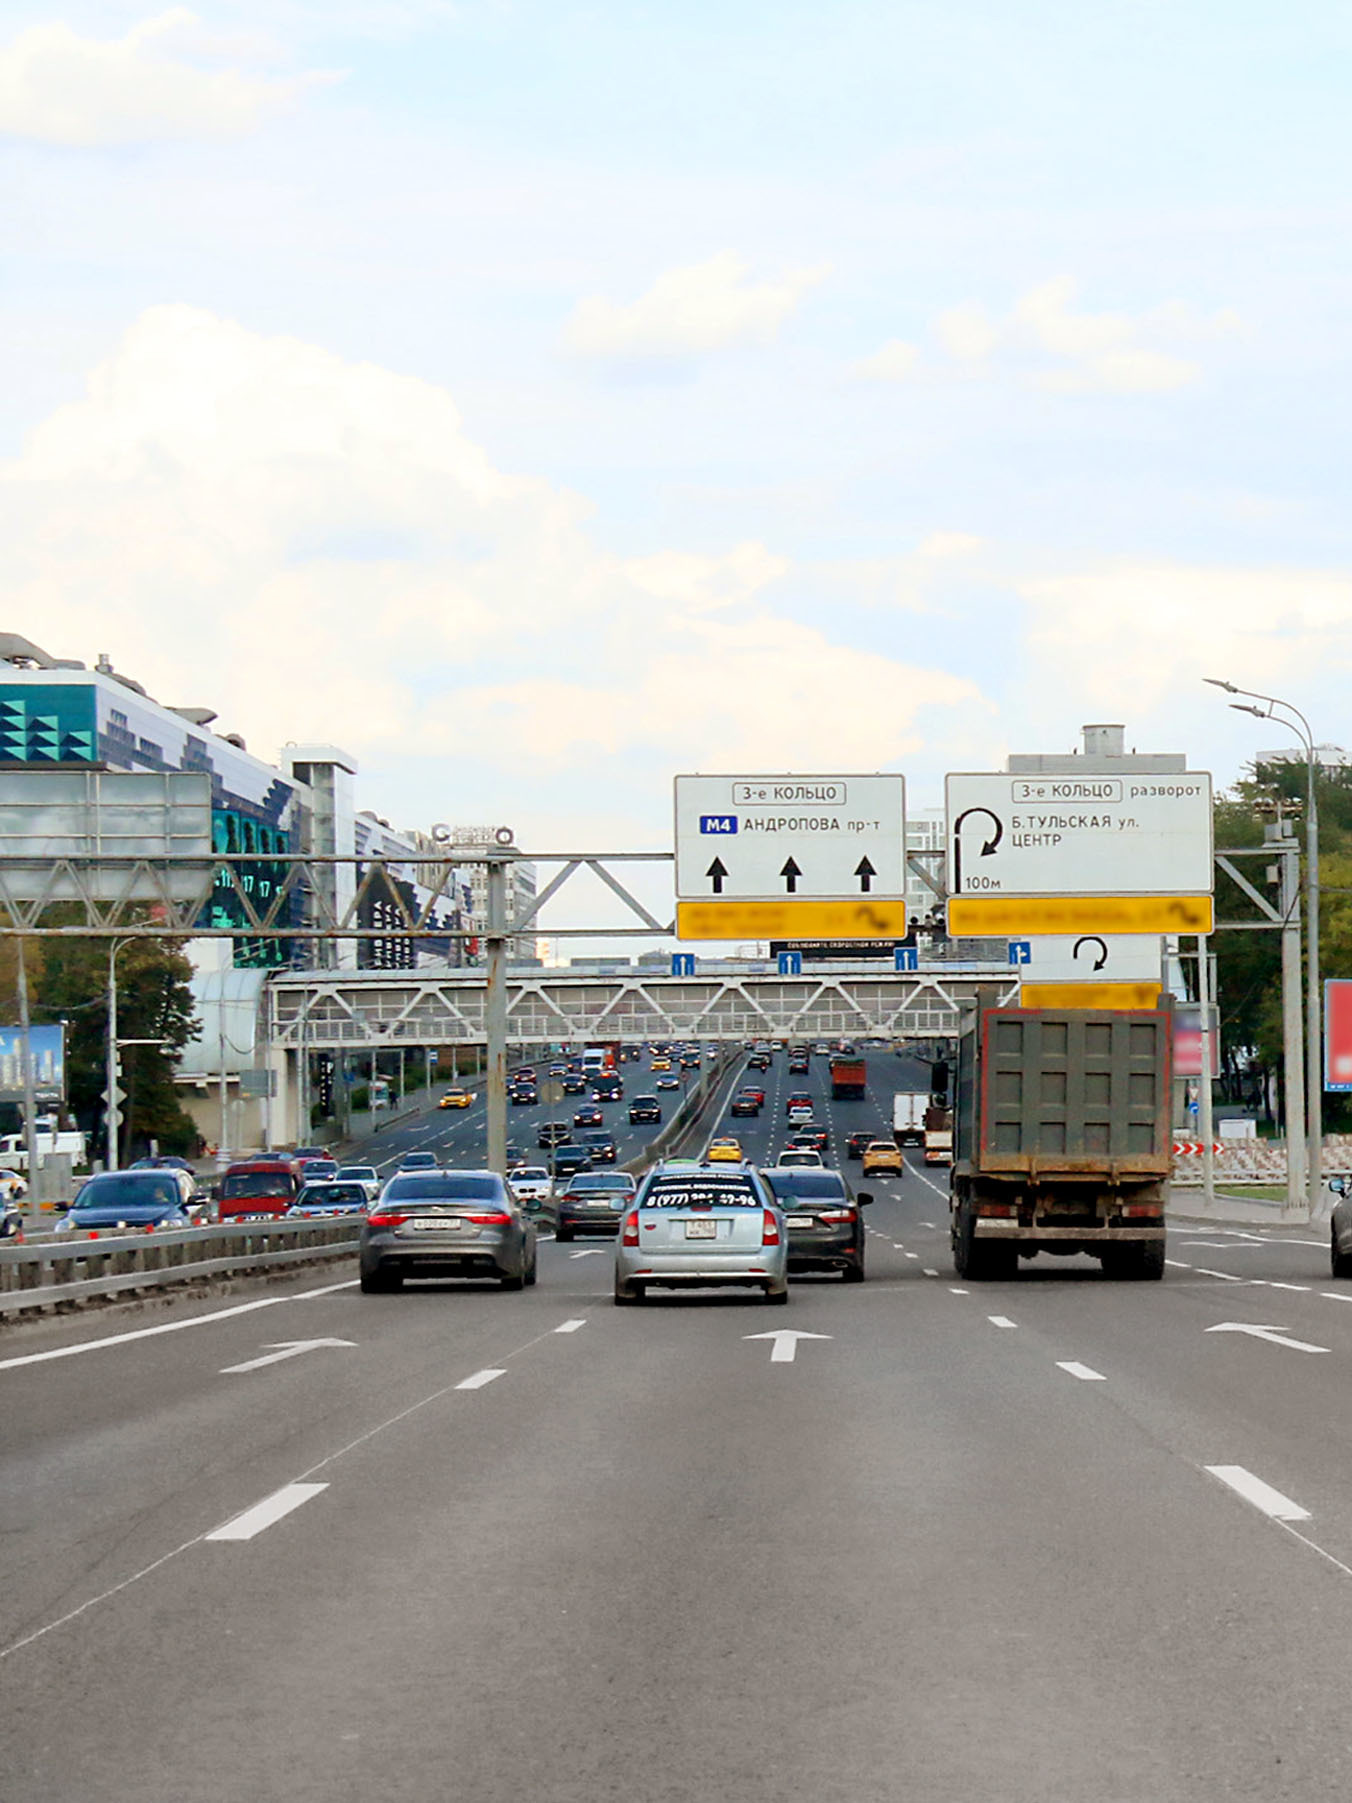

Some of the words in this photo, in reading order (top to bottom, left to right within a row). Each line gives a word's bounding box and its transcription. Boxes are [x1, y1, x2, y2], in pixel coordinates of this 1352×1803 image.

[743, 786, 767, 800] 3-е
[774, 786, 837, 801] КОЛЬЦО
[1022, 784, 1045, 798] 3-е
[1052, 784, 1113, 800] КОЛЬЦО
[1130, 786, 1201, 799] разворот
[706, 818, 732, 832] М4
[744, 817, 840, 832] АНДРОПОВА
[847, 820, 881, 833] пр-т
[1011, 815, 1112, 829] Б.ТУЛЬСКАЯ
[1118, 817, 1140, 830] ул.
[1011, 834, 1062, 849] ЦЕНТР
[965, 876, 1001, 890] 100м
